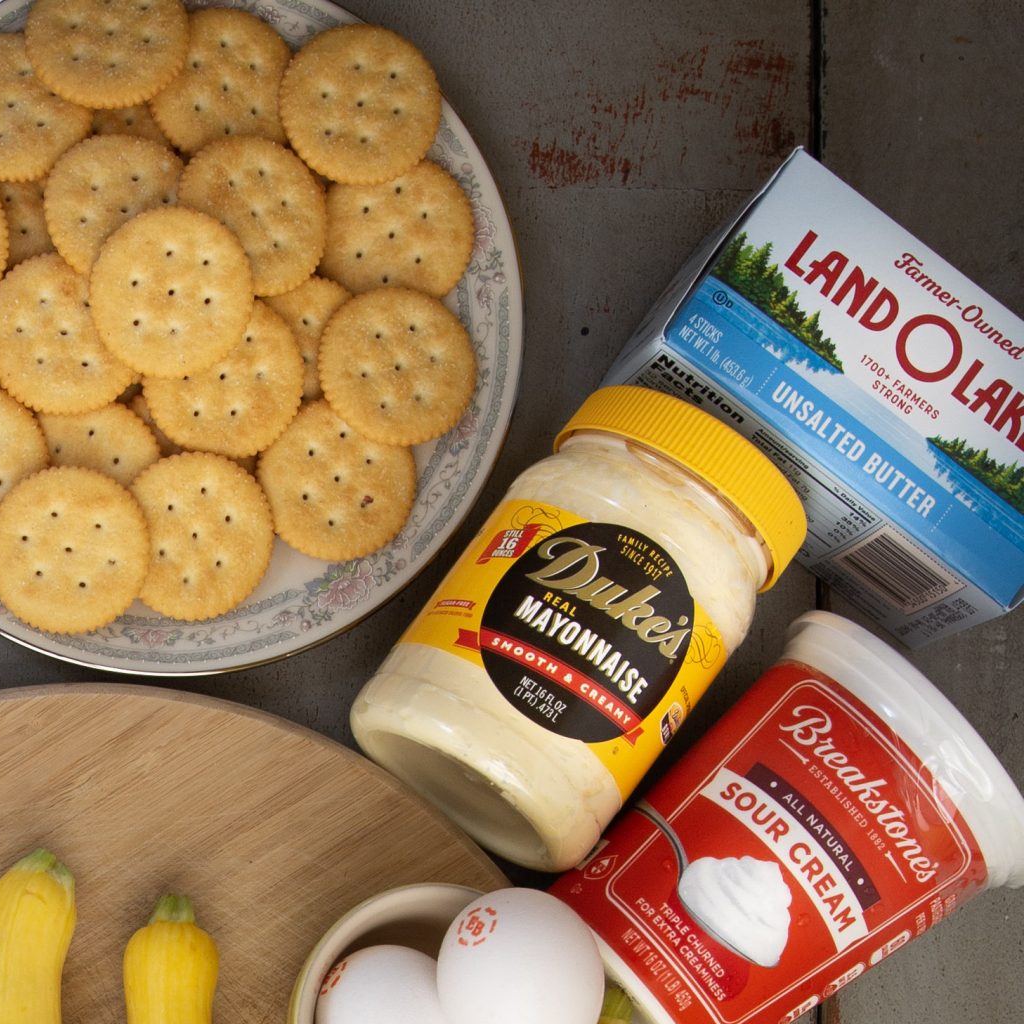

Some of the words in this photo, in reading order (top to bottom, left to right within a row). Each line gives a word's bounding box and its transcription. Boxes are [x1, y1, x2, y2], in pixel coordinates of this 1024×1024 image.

[784, 229, 899, 332] LAND
[895, 314, 963, 382] O
[894, 252, 1024, 360] Farmer-Owned
[678, 325, 698, 344] NET
[694, 335, 710, 357] WT.
[688, 314, 698, 325] 4
[695, 317, 723, 343] STICKS
[650, 362, 704, 405] Facts
[656, 354, 745, 424] Nutrition
[860, 354, 890, 381] 1700+
[892, 379, 940, 420] FARMERS
[872, 380, 912, 415] STRONG
[758, 428, 809, 470] Amount/serving
[771, 381, 866, 462] UNSALTED
[862, 452, 936, 518] BUTTER
[840, 493, 857, 507] Daily
[858, 505, 876, 521] Value
[491, 549, 515, 558] OUNCES
[497, 538, 519, 550] 16
[503, 530, 524, 538] STILL
[617, 533, 649, 551] FAMILY
[650, 550, 673, 577] RECIPE
[620, 545, 642, 566] SINCE
[643, 562, 664, 581] 1917
[525, 536, 691, 659] Duke's
[543, 592, 577, 617] REAL
[514, 595, 649, 704] MAYONNAISE
[491, 637, 558, 674] SMOOTH
[563, 673, 574, 684] &
[580, 683, 631, 725] CREAMY
[513, 684, 524, 697] (1
[519, 676, 537, 691] NET
[535, 686, 546, 699] 16
[545, 690, 556, 704] FL
[554, 700, 567, 714] OZ
[779, 705, 940, 883] Breakstone's
[808, 765, 868, 828] ESTABLISHED
[866, 828, 886, 850] 1882
[782, 793, 803, 816] ALL
[806, 814, 855, 872] NATURAL
[720, 782, 790, 844] SOUR
[789, 842, 856, 933] CREAM
[621, 927, 641, 946] NET
[633, 940, 651, 956] WT
[636, 897, 656, 917] FOR
[652, 916, 681, 946] EXTRA
[679, 945, 726, 1001] CREAMINESS
[659, 902, 690, 935] TRIPLE
[687, 934, 725, 978] CHURNED
[643, 952, 658, 966] 16
[650, 960, 666, 975] OZ
